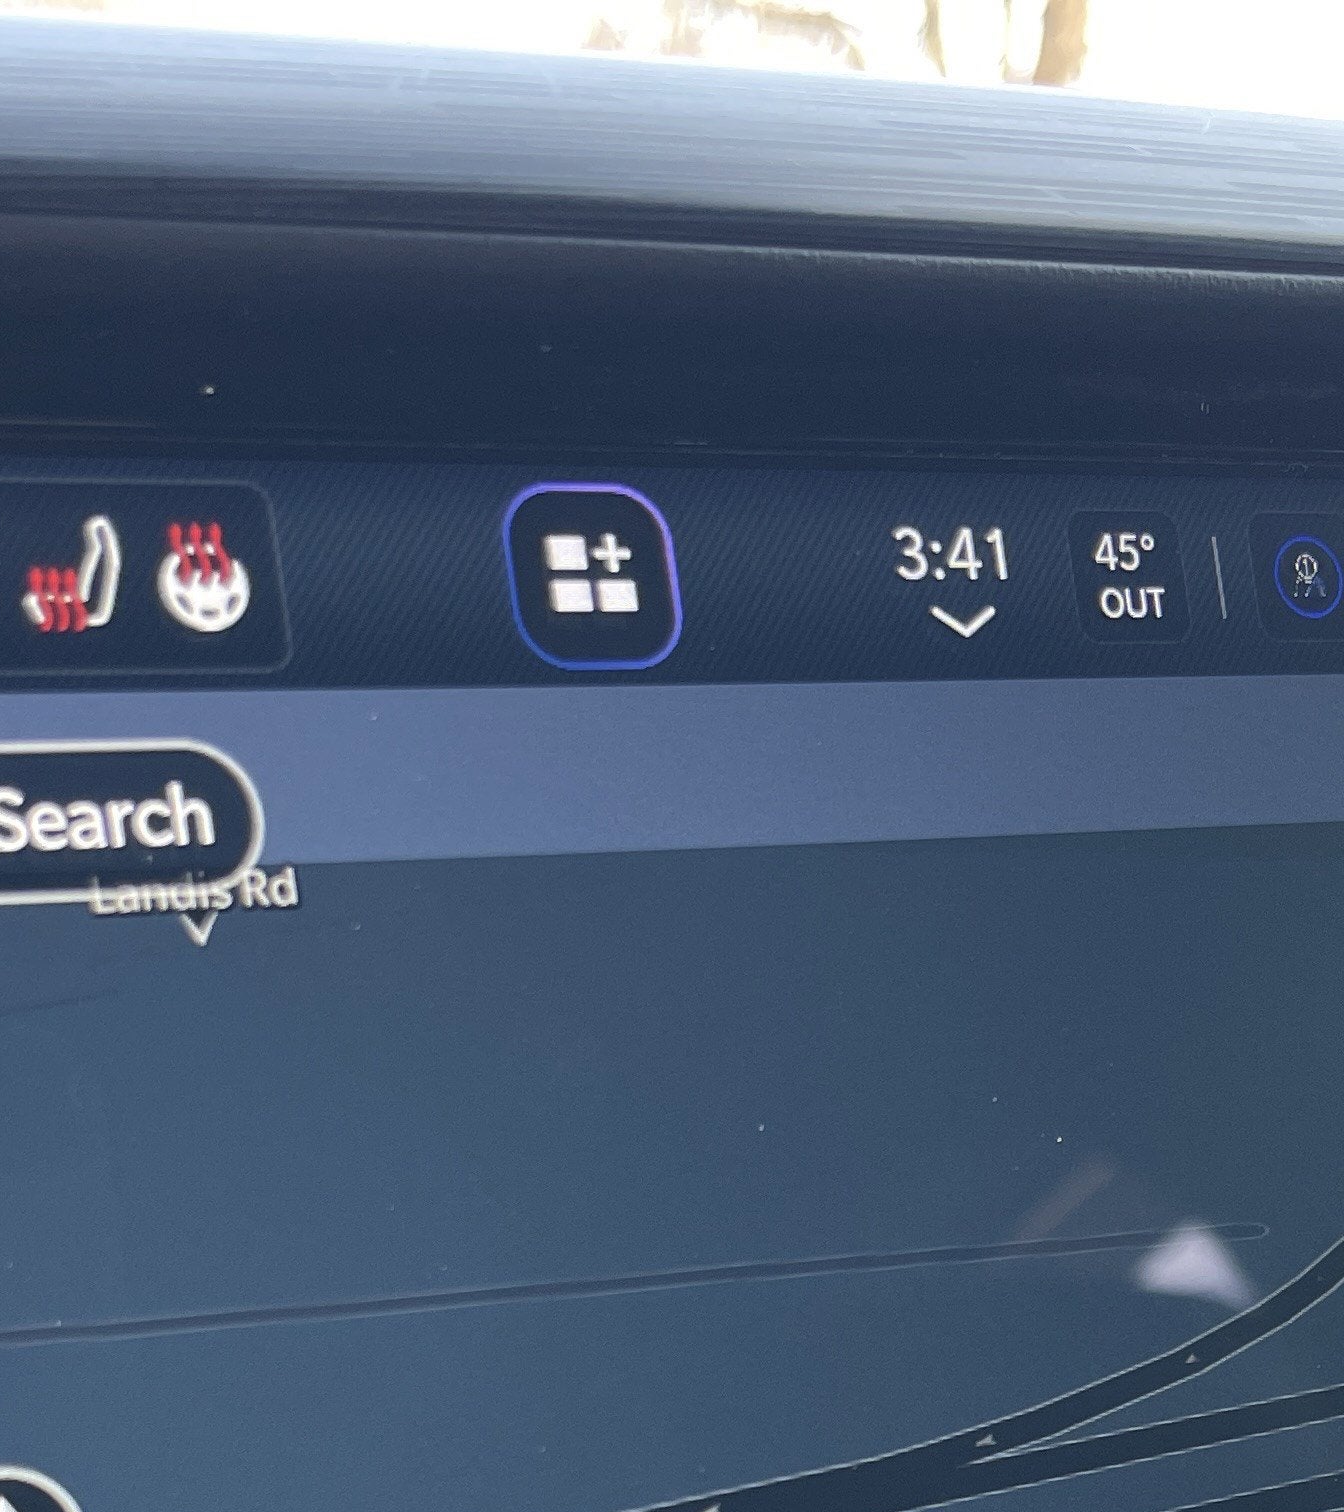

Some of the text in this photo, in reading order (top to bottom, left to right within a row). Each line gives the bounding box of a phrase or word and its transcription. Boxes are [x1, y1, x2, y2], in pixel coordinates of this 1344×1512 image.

[893, 525, 1011, 582] 3:41
[1093, 531, 1156, 571] 45°
[1099, 587, 1165, 619] OUT
[238, 865, 299, 908] Rd
